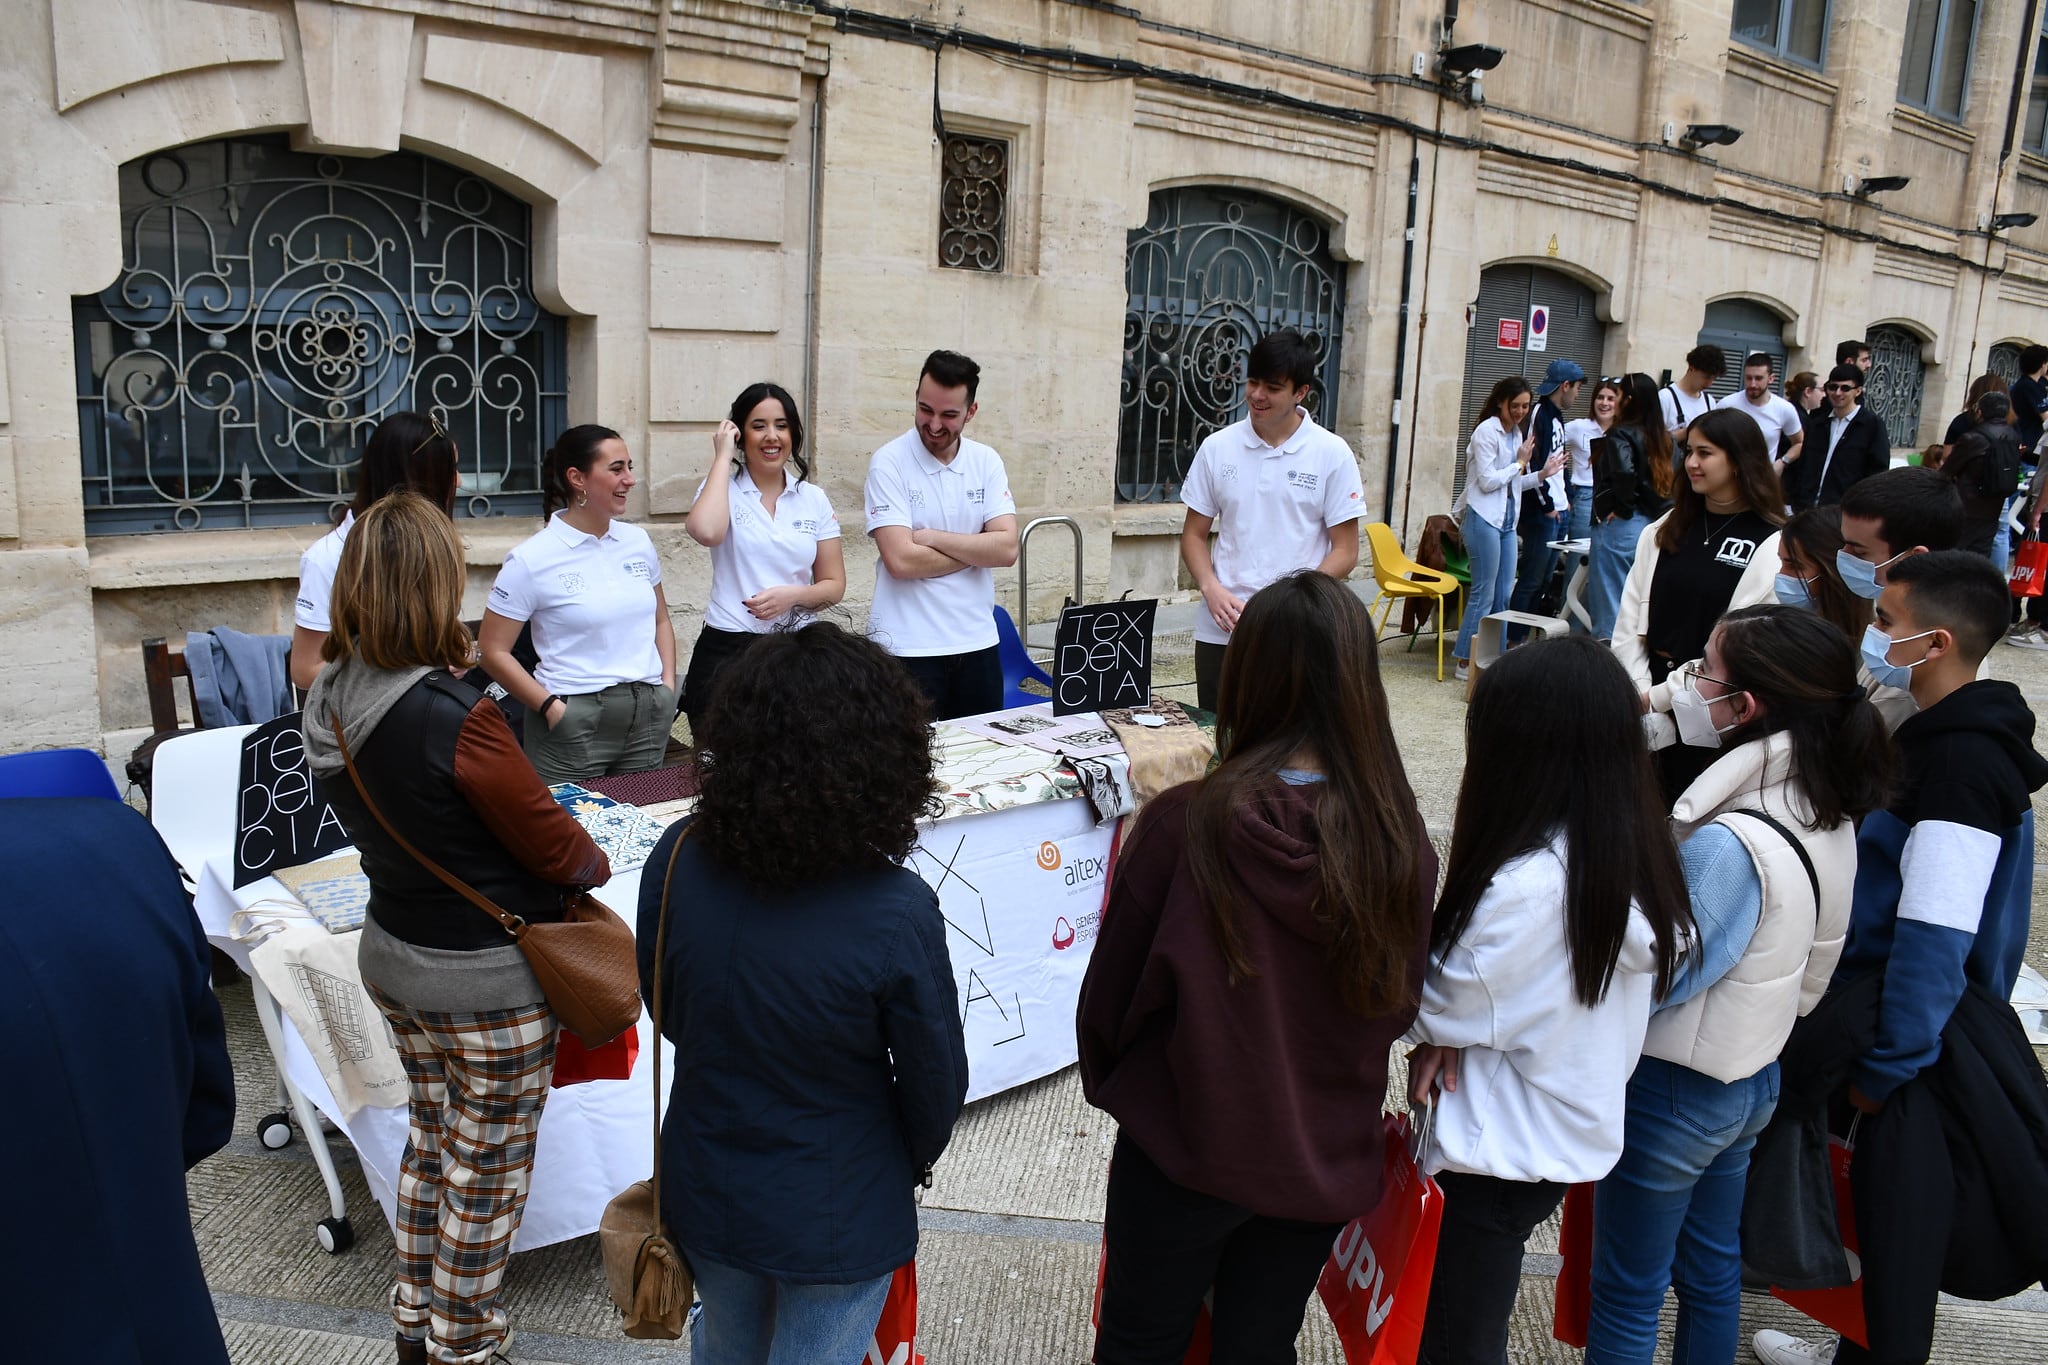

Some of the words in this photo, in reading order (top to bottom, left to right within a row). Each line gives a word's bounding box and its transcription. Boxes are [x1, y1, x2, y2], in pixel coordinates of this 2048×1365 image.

[2010, 565, 2036, 582] UPV
[1059, 669, 1142, 706] CIA
[240, 802, 348, 870] CIA
[1063, 855, 1104, 887] aitex
[1333, 1221, 1394, 1338] UPV
